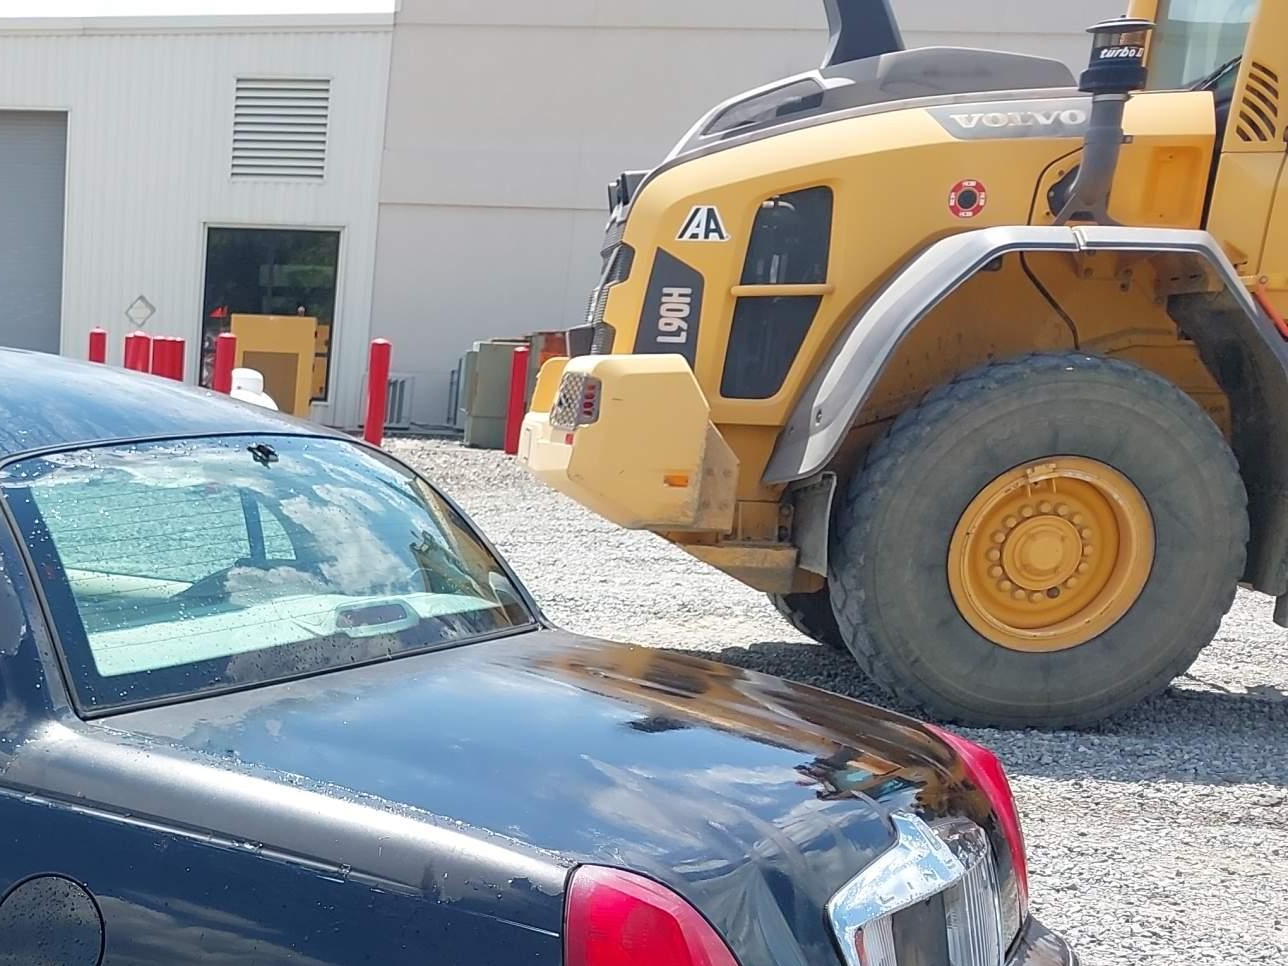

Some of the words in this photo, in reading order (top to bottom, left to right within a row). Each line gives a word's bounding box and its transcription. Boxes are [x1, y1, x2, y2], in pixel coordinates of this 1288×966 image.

[1099, 46, 1136, 59] turbo
[949, 109, 1086, 129] VOLVO
[656, 287, 692, 343] L90H
